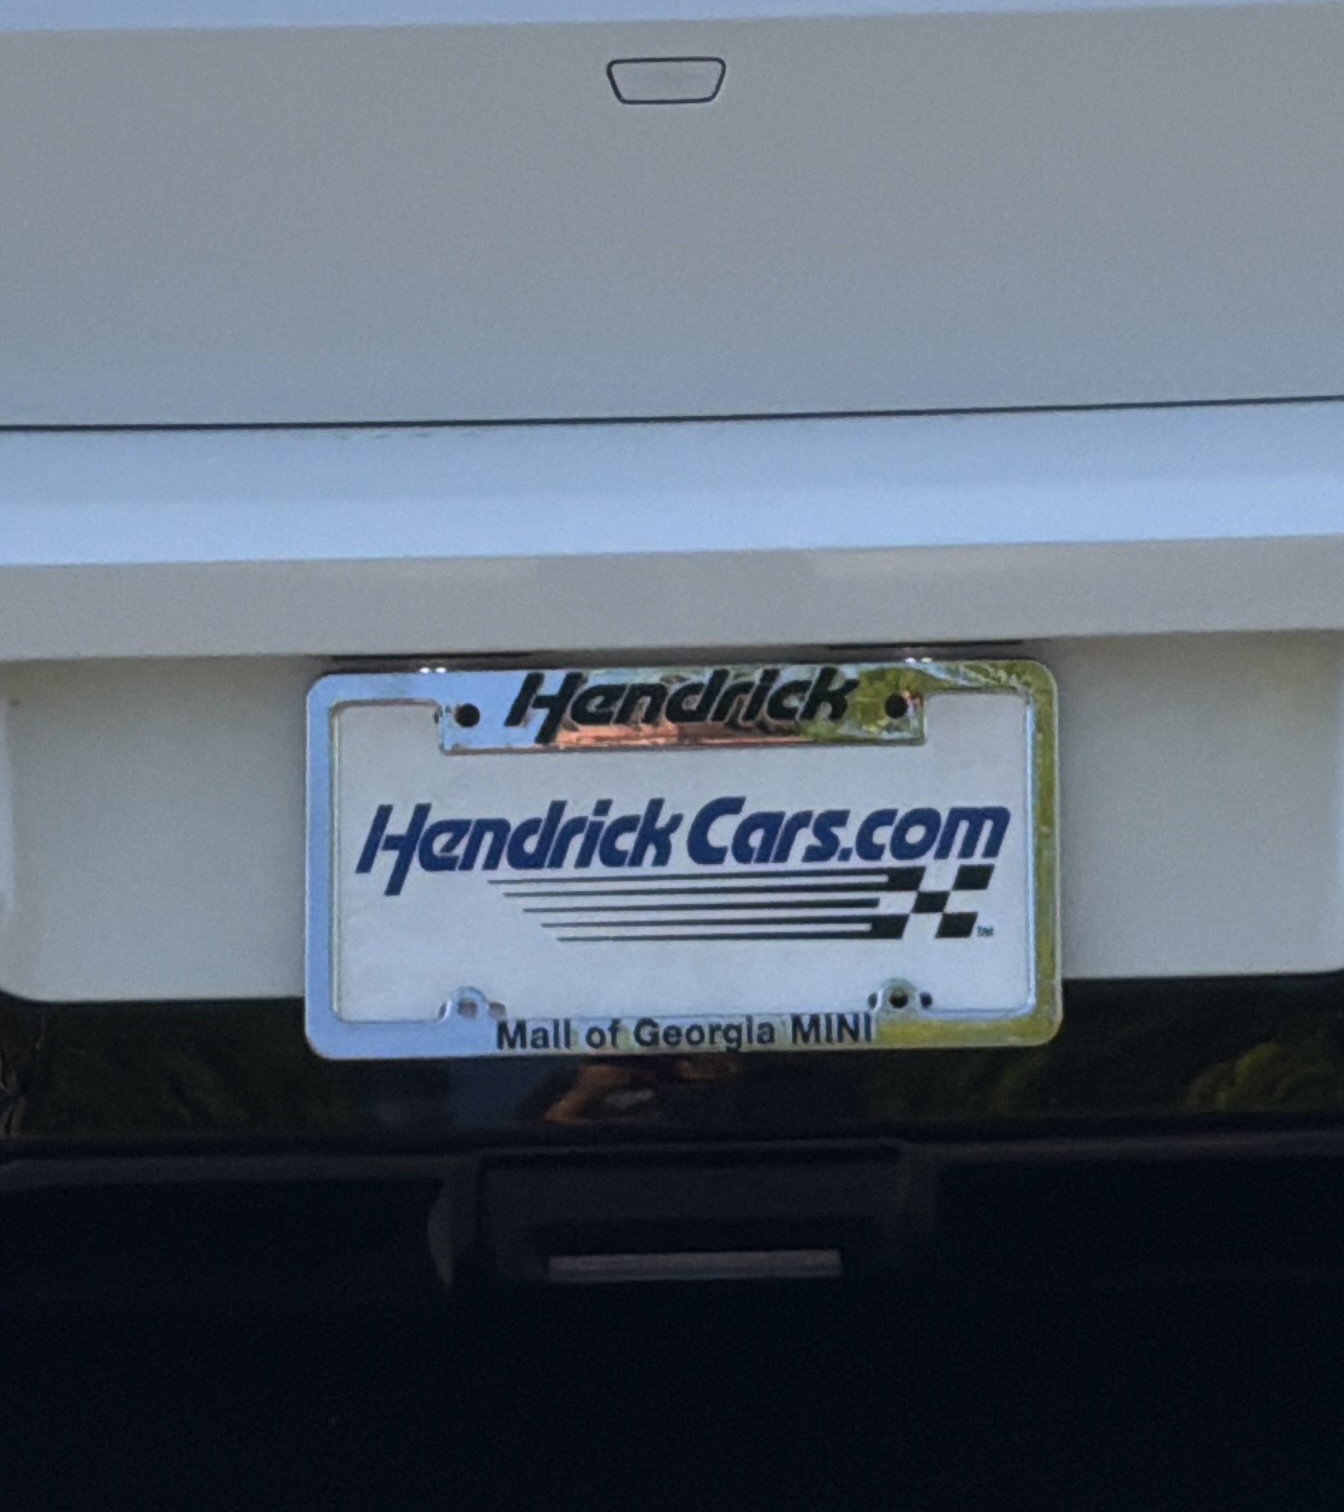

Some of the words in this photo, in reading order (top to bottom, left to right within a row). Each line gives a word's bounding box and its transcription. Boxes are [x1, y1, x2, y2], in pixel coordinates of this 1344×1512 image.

[503, 665, 860, 744] Hendrick
[496, 1018, 572, 1051] Mall
[584, 1018, 620, 1048] of
[633, 1015, 776, 1052] Georgia
[790, 1012, 873, 1044] MINI
